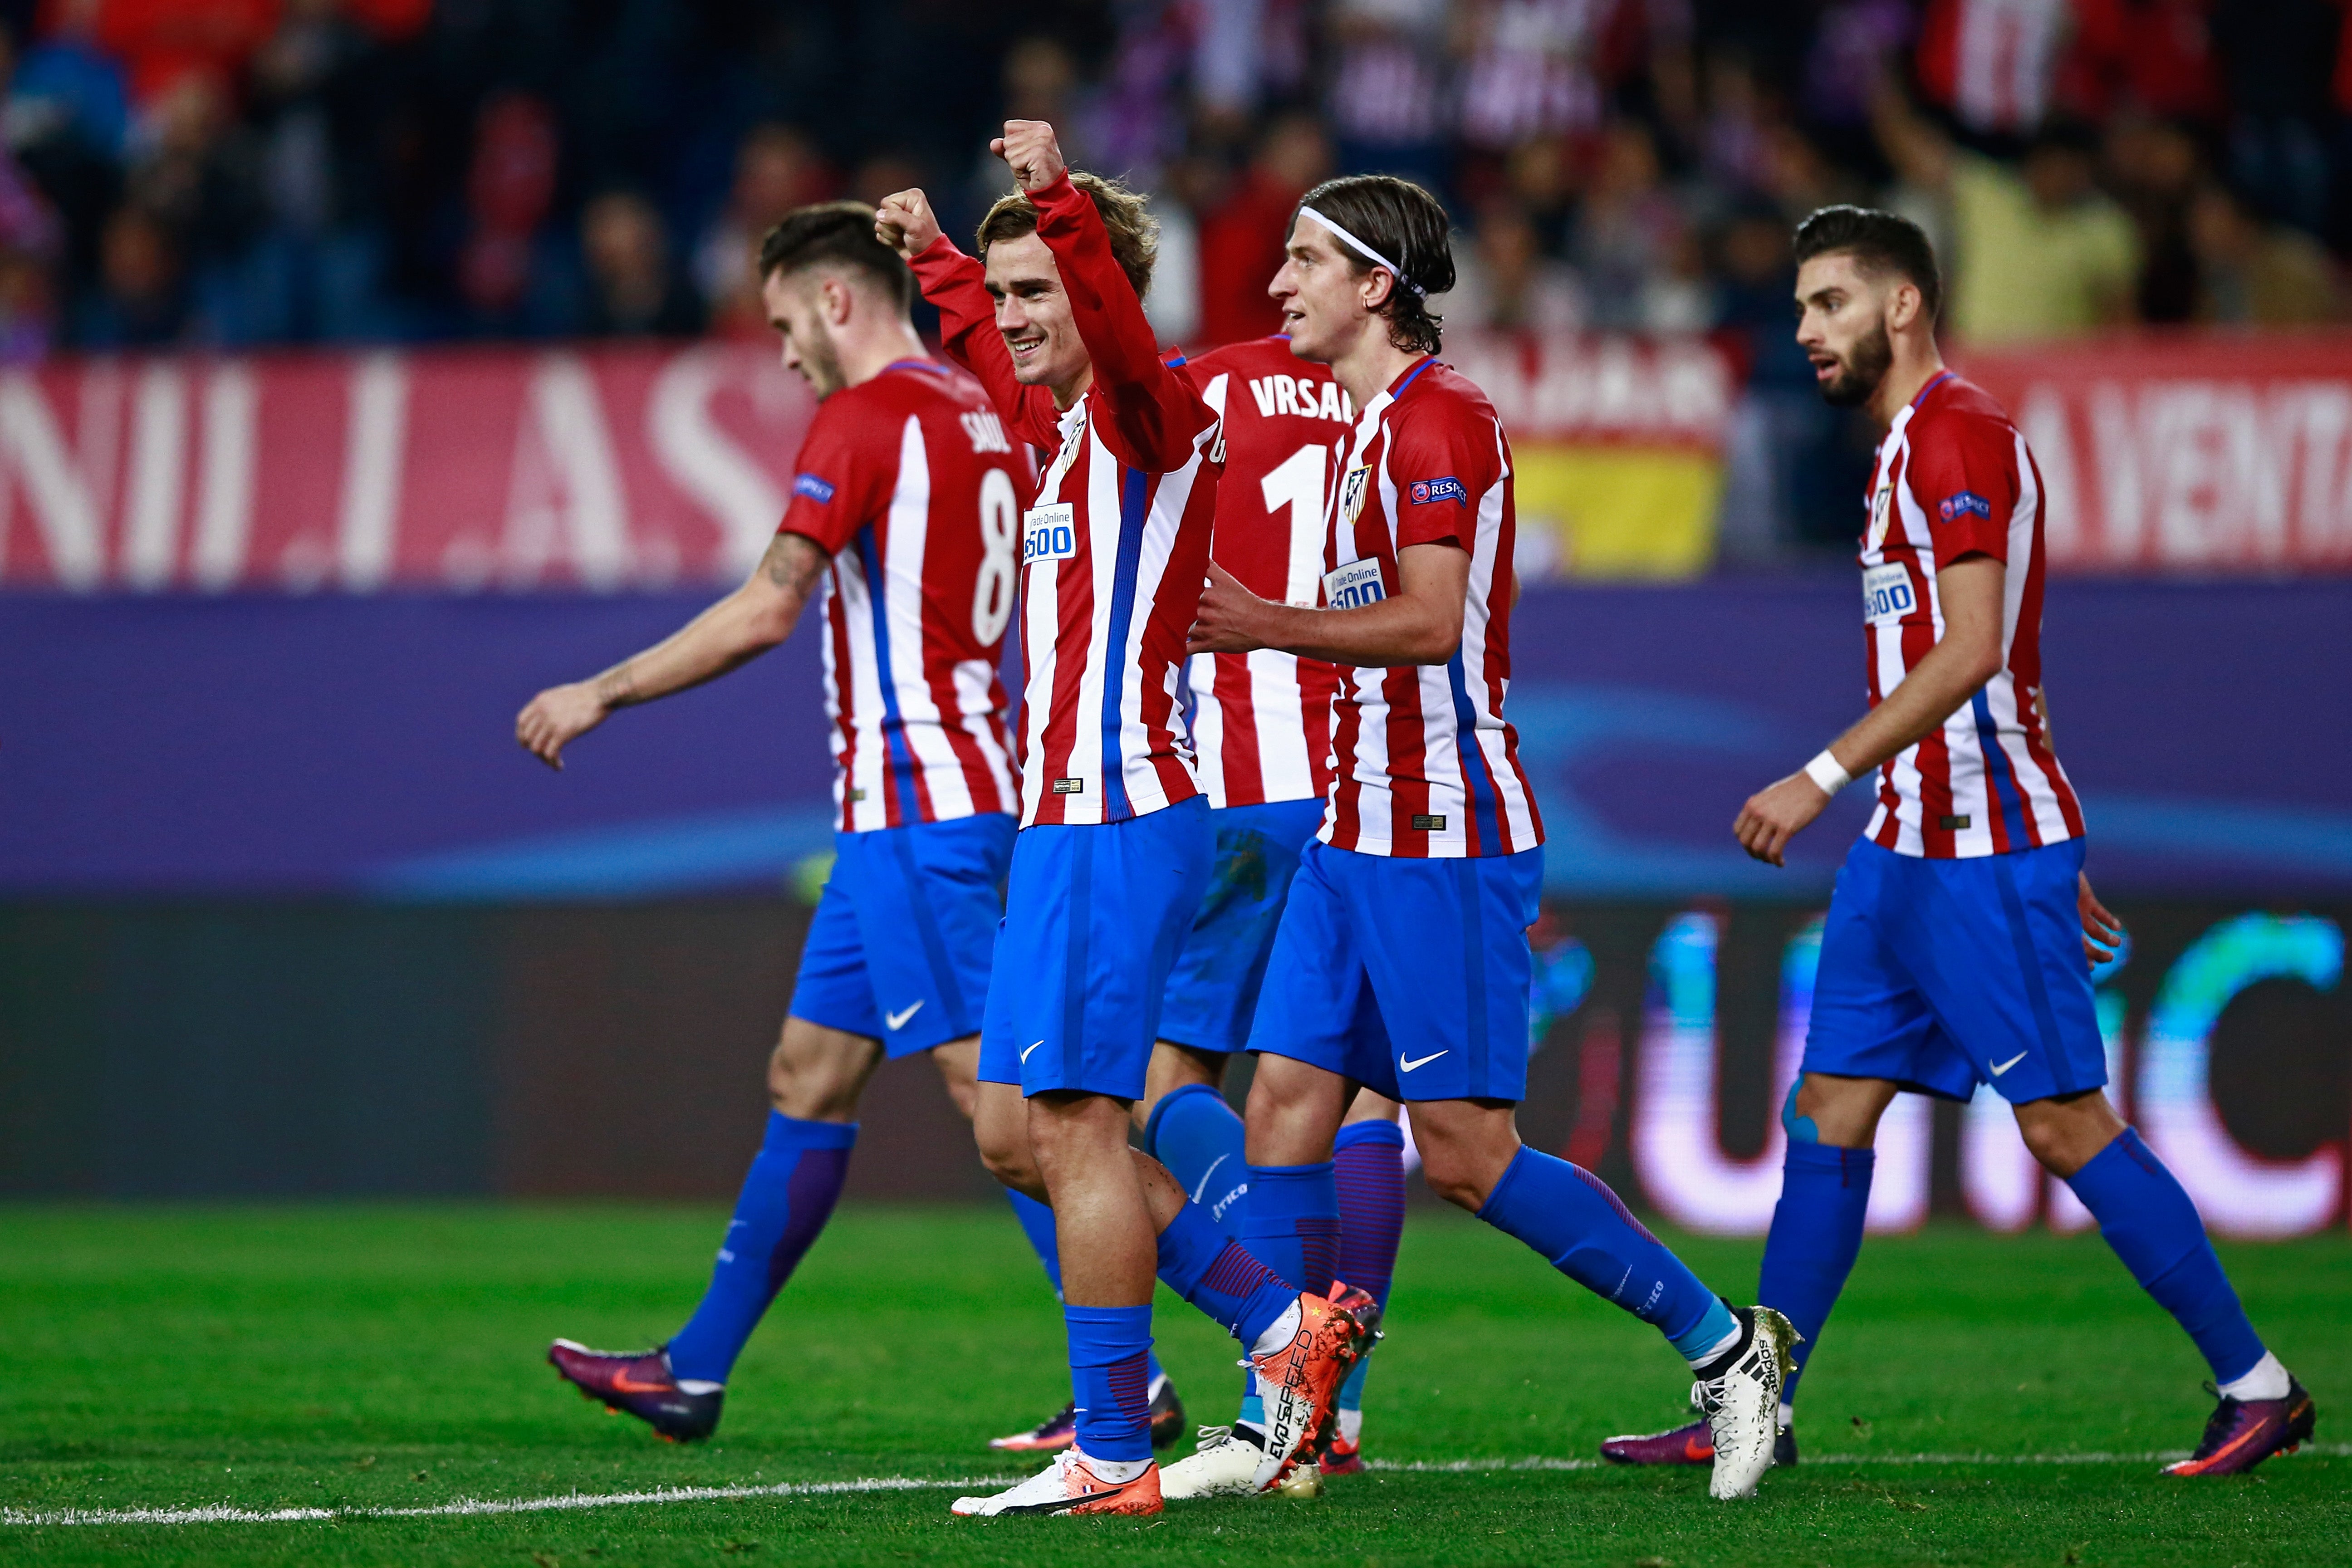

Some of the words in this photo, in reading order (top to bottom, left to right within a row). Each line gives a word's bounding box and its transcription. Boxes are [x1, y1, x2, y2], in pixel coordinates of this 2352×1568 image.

[1431, 482, 1466, 502] RESPECT
[1044, 512, 1069, 524] Online
[971, 467, 1018, 647] 8
[1348, 568, 1377, 583] Online
[1759, 1340, 1779, 1395] adidas
[1270, 1330, 1313, 1460] EVOSPEED
